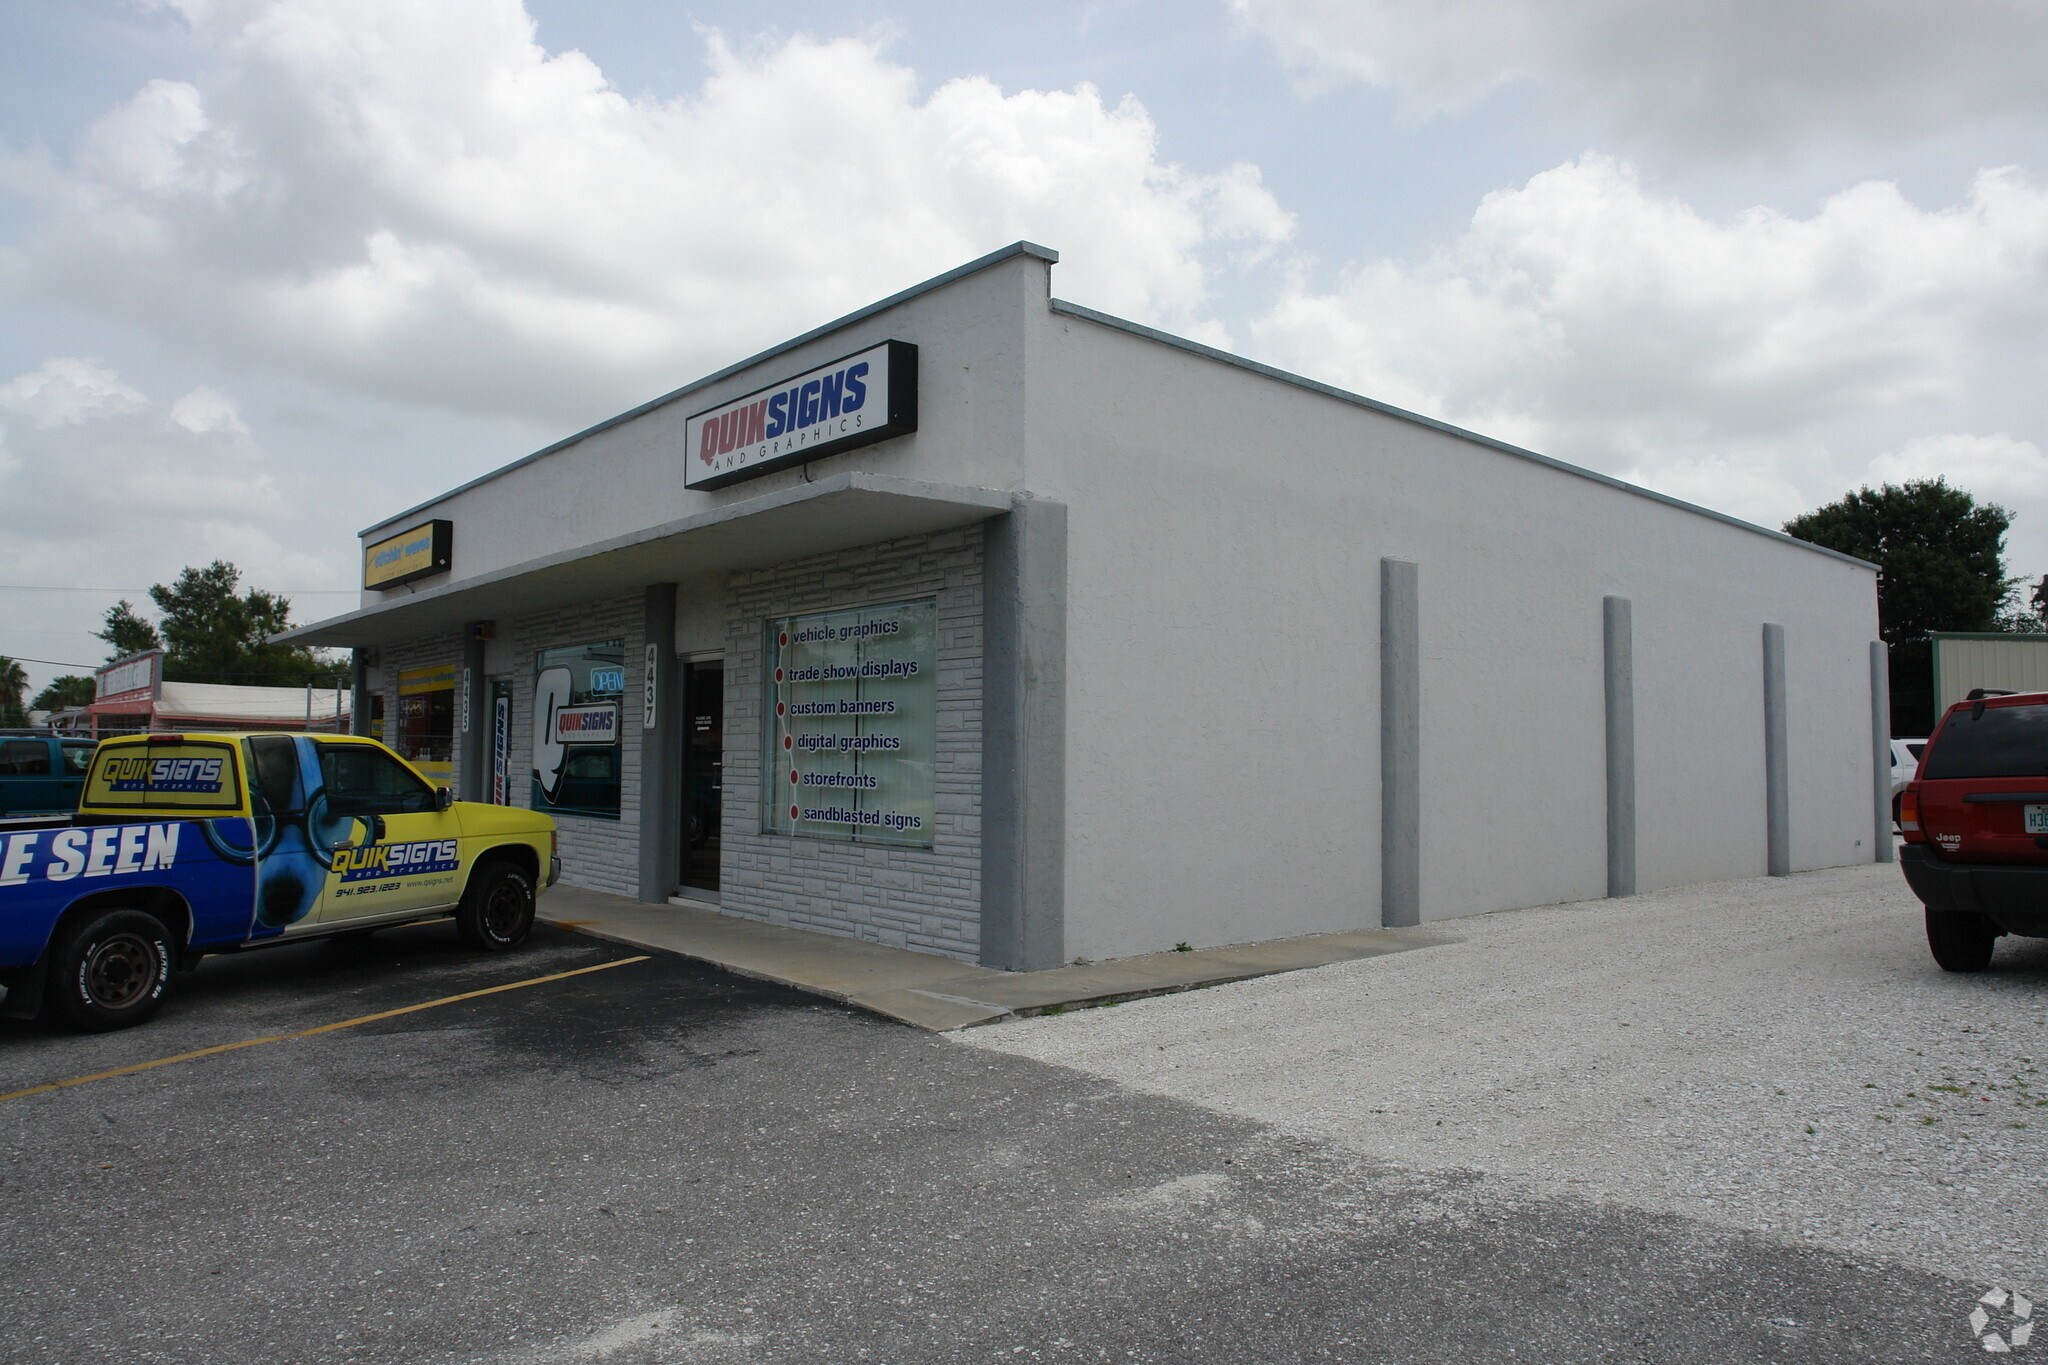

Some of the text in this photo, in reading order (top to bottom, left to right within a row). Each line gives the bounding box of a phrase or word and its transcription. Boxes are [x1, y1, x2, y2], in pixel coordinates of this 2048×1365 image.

[700, 361, 869, 466] QUIKSIGNS
[714, 414, 862, 471] AND GRAPHICS
[793, 619, 899, 643] vehicle graphics
[593, 671, 624, 691] OPEN
[789, 660, 918, 681] trade show displays
[646, 647, 655, 724] 4437
[790, 699, 895, 715] custom banners
[559, 711, 614, 734] QUIKSIGNS
[798, 734, 900, 752] digital graphics
[803, 772, 877, 788] storefronts
[804, 807, 921, 830] sandblasted signs
[1936, 833, 1961, 843] Jeep
[0, 823, 180, 886] E SEEN
[407, 877, 453, 888] www.qsigns.net
